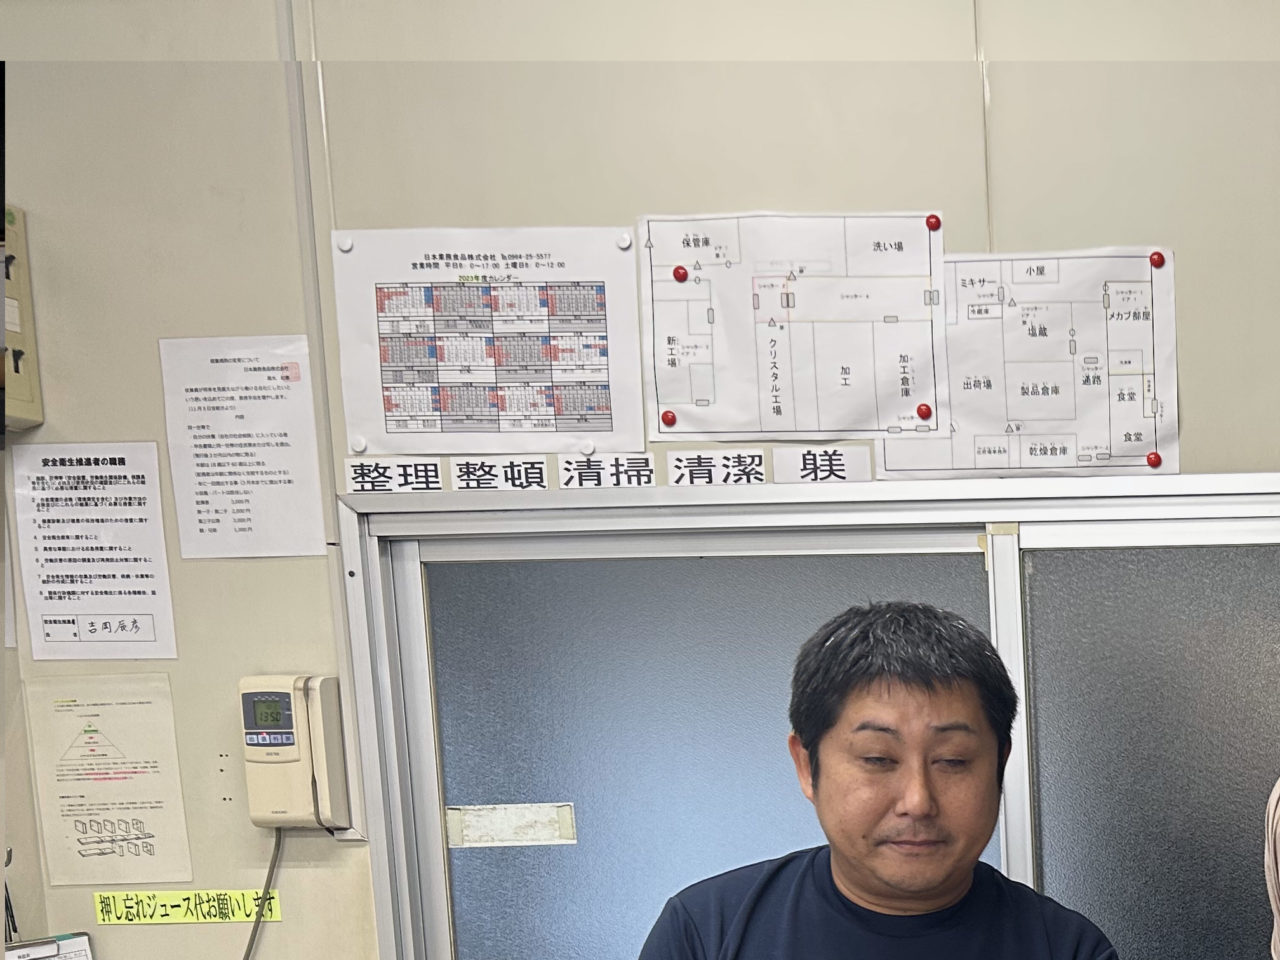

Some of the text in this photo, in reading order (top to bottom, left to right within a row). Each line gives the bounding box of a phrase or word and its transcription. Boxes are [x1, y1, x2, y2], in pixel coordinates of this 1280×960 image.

[682, 237, 710, 248] 保管庫
[873, 241, 904, 252] 洗い場
[1025, 265, 1046, 277] 小屋
[960, 278, 997, 288] ミキサー
[667, 336, 677, 368] 新工場
[769, 338, 783, 417] クリスタル工場
[840, 365, 851, 387] 加工
[899, 354, 912, 398] 加工倉庫
[1082, 375, 1102, 386] 通路
[963, 379, 993, 391] 出荷場
[1020, 385, 1060, 397] 製品倉庫
[1117, 391, 1137, 402] 食堂
[1123, 432, 1143, 442] 食堂
[1029, 445, 1068, 457] 乾燥倉庫
[41, 457, 126, 467] 安全衛生推進者の職務
[350, 450, 847, 493] 整理 整頓 清掃 清潔 躾
[99, 892, 276, 922] 押し忘れジュース代お願いします
